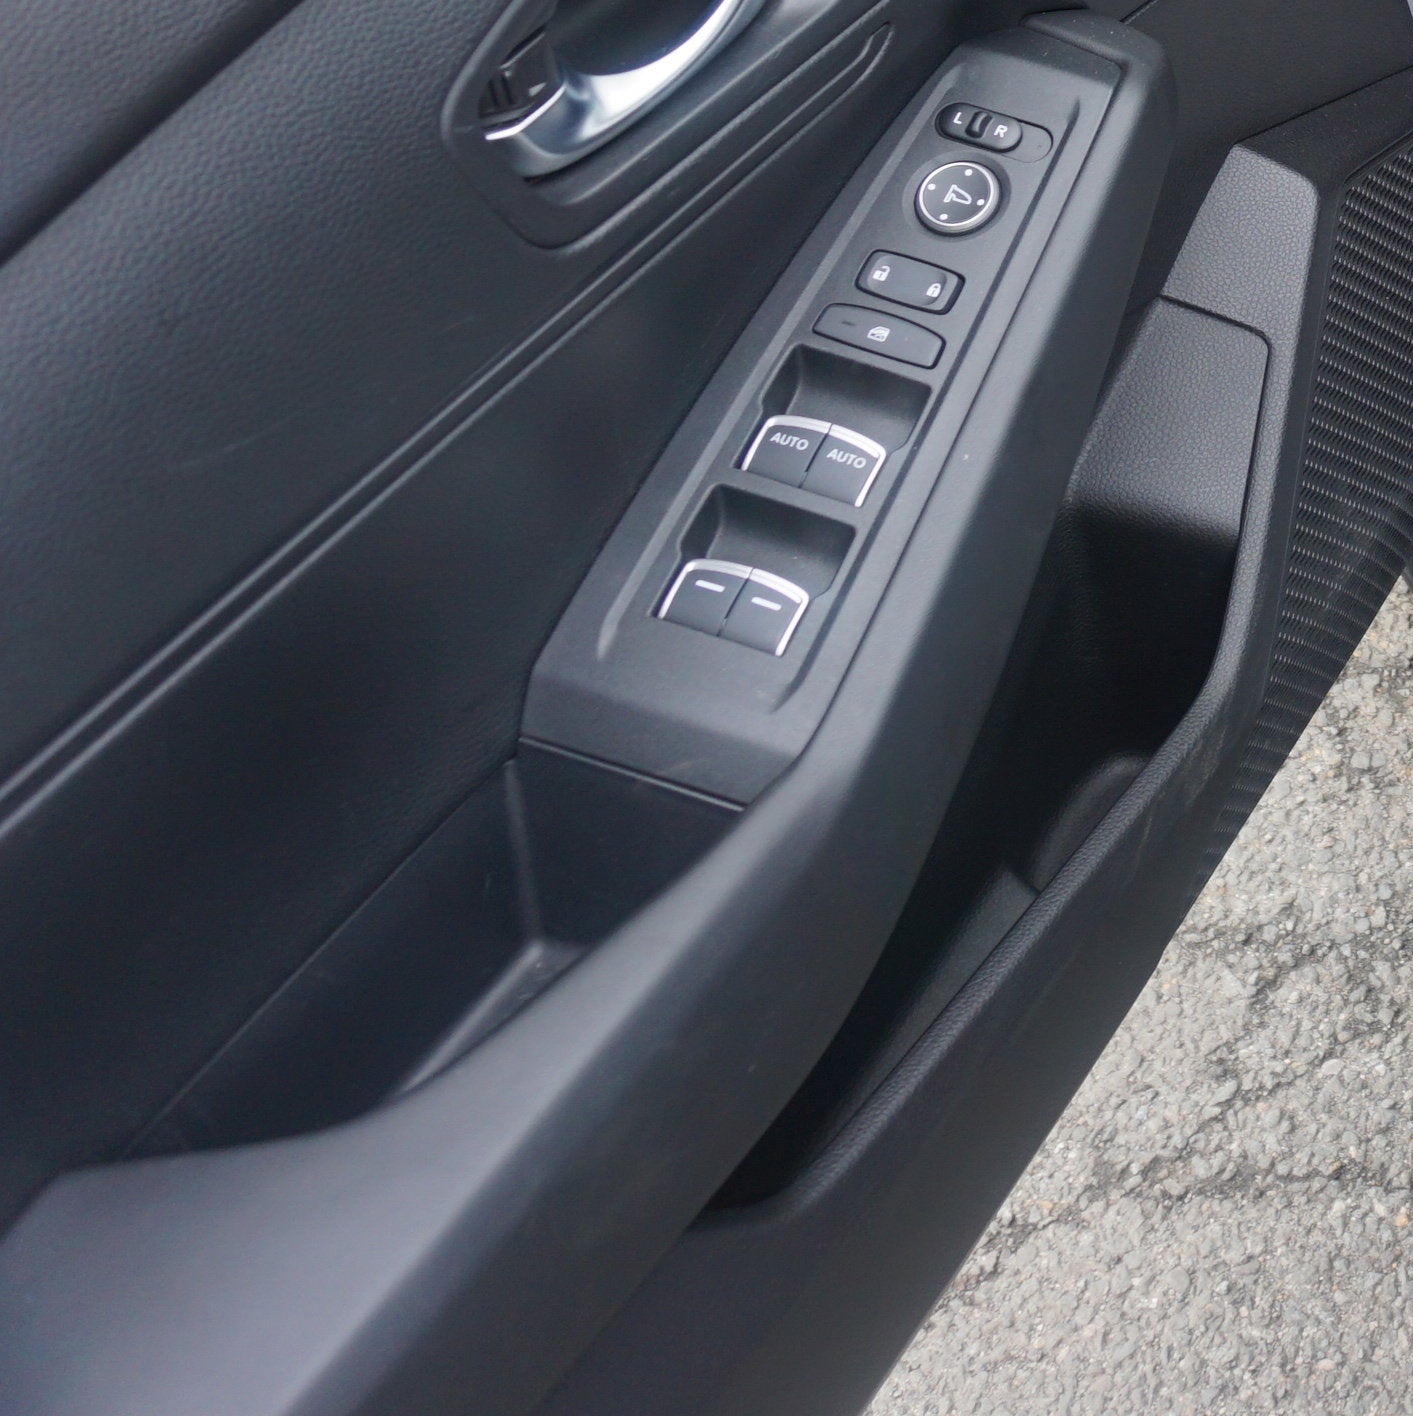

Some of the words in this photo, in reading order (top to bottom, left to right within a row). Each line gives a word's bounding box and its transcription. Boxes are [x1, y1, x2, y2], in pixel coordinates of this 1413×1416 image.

[952, 111, 963, 125] L
[993, 124, 1008, 138] R
[769, 431, 809, 451] AUTO
[825, 447, 867, 469] AUTO
